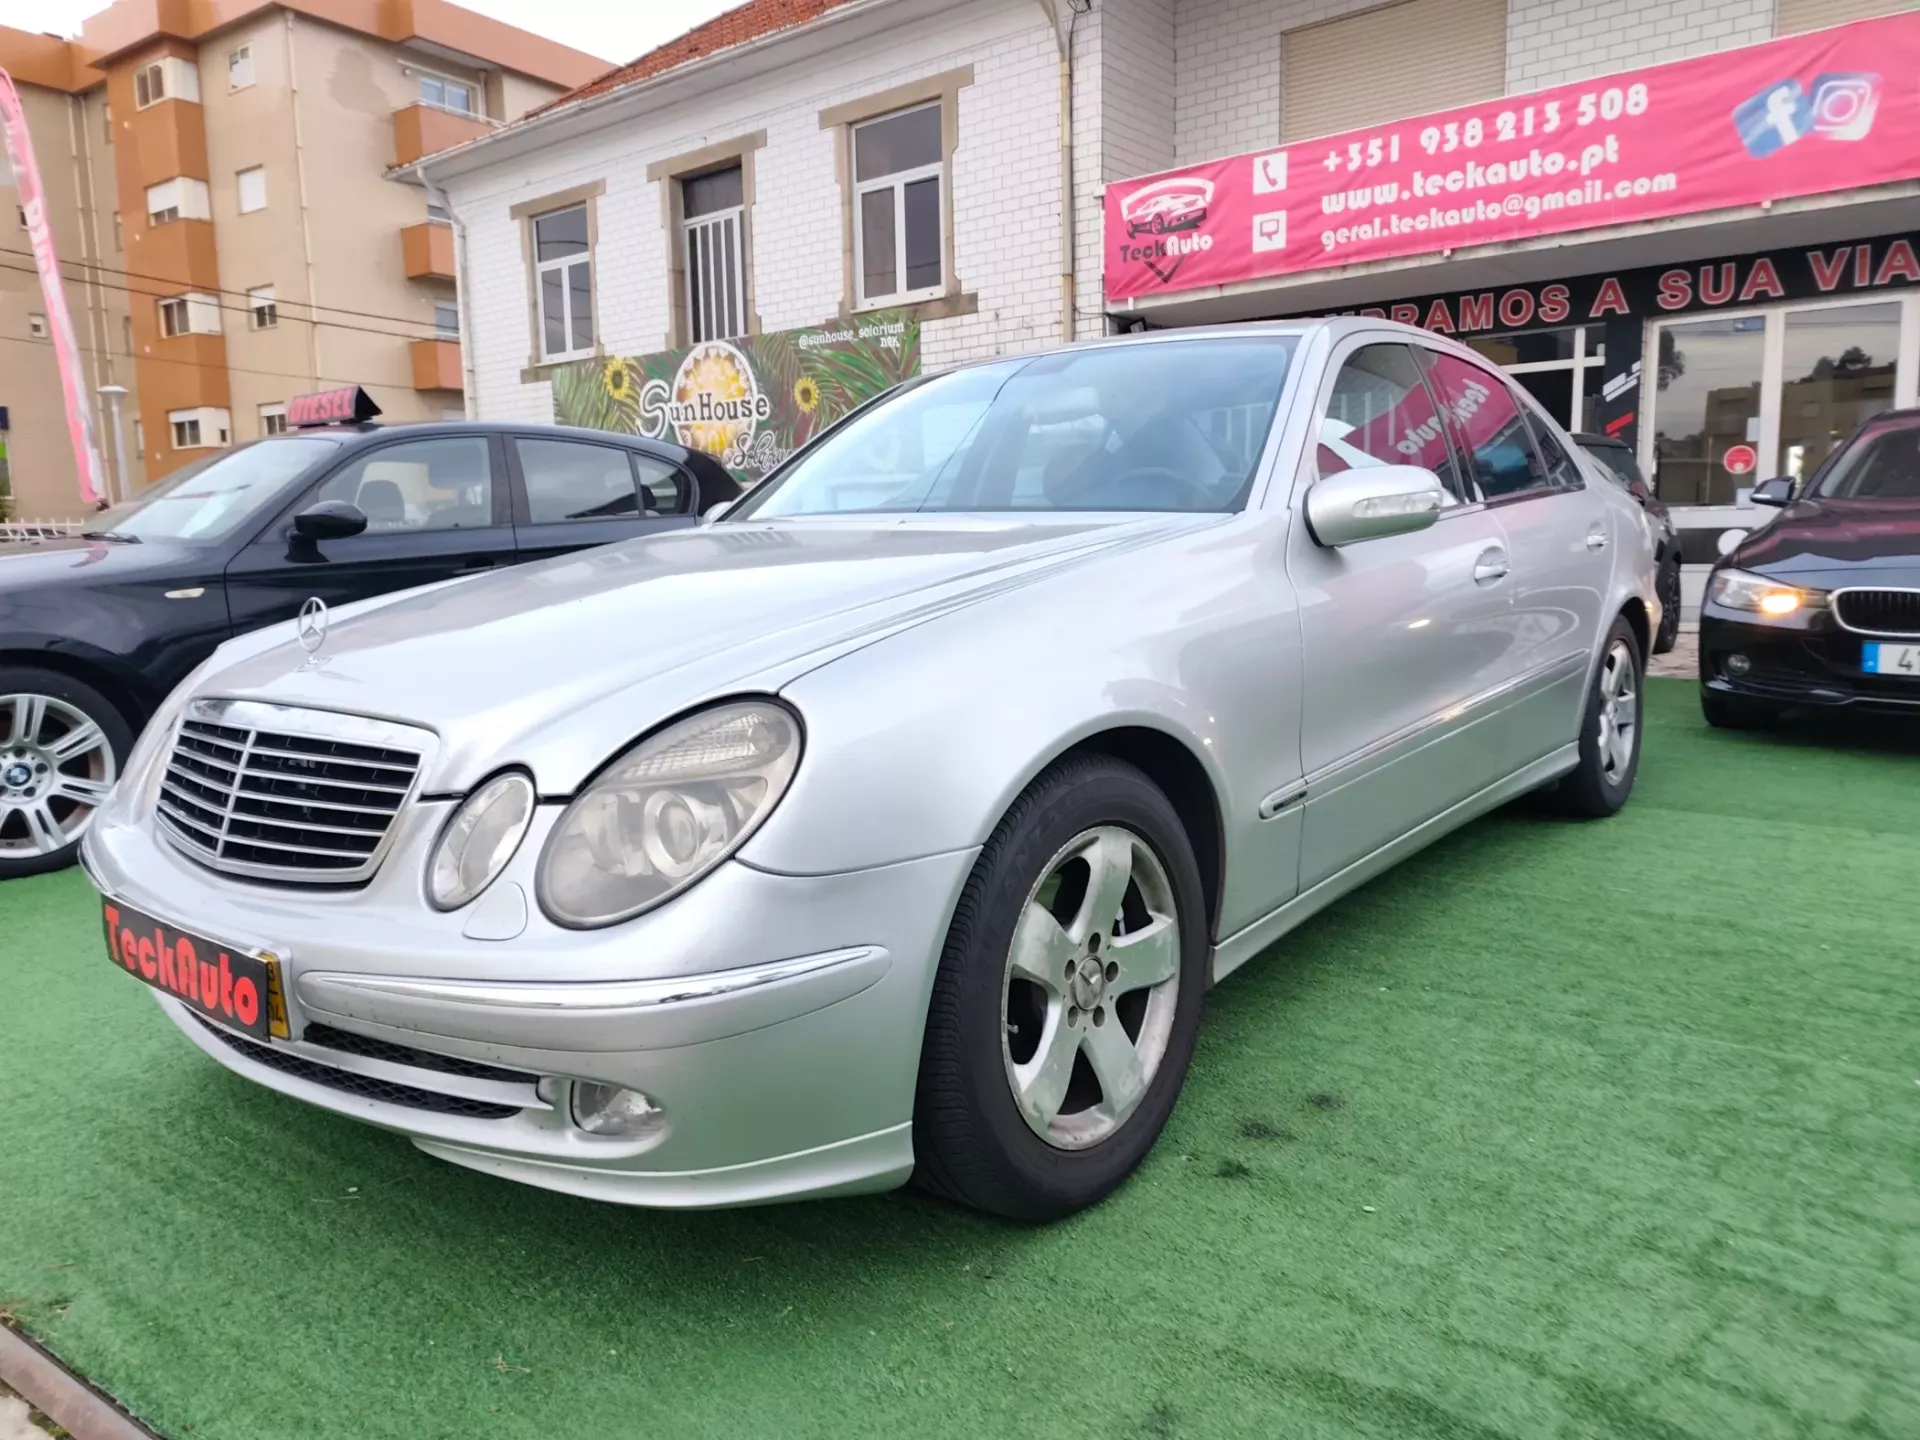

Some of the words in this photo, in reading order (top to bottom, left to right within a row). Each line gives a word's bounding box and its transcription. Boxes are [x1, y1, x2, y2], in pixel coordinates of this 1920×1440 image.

[1323, 134, 1400, 173] +351
[1420, 118, 1483, 155] 938
[1496, 102, 1561, 142] 213
[1577, 83, 1649, 126] 508
[1321, 134, 1620, 215] www.teckauto.pt
[1119, 231, 1214, 263] TeckAuto
[1320, 172, 1677, 252] geral.teckauto@gmail.com
[1588, 277, 1631, 318] A
[1656, 257, 1785, 311] SUA
[636, 378, 770, 440] SunHouse
[1898, 647, 1920, 672] 4
[104, 903, 259, 1026] TeckAuto
